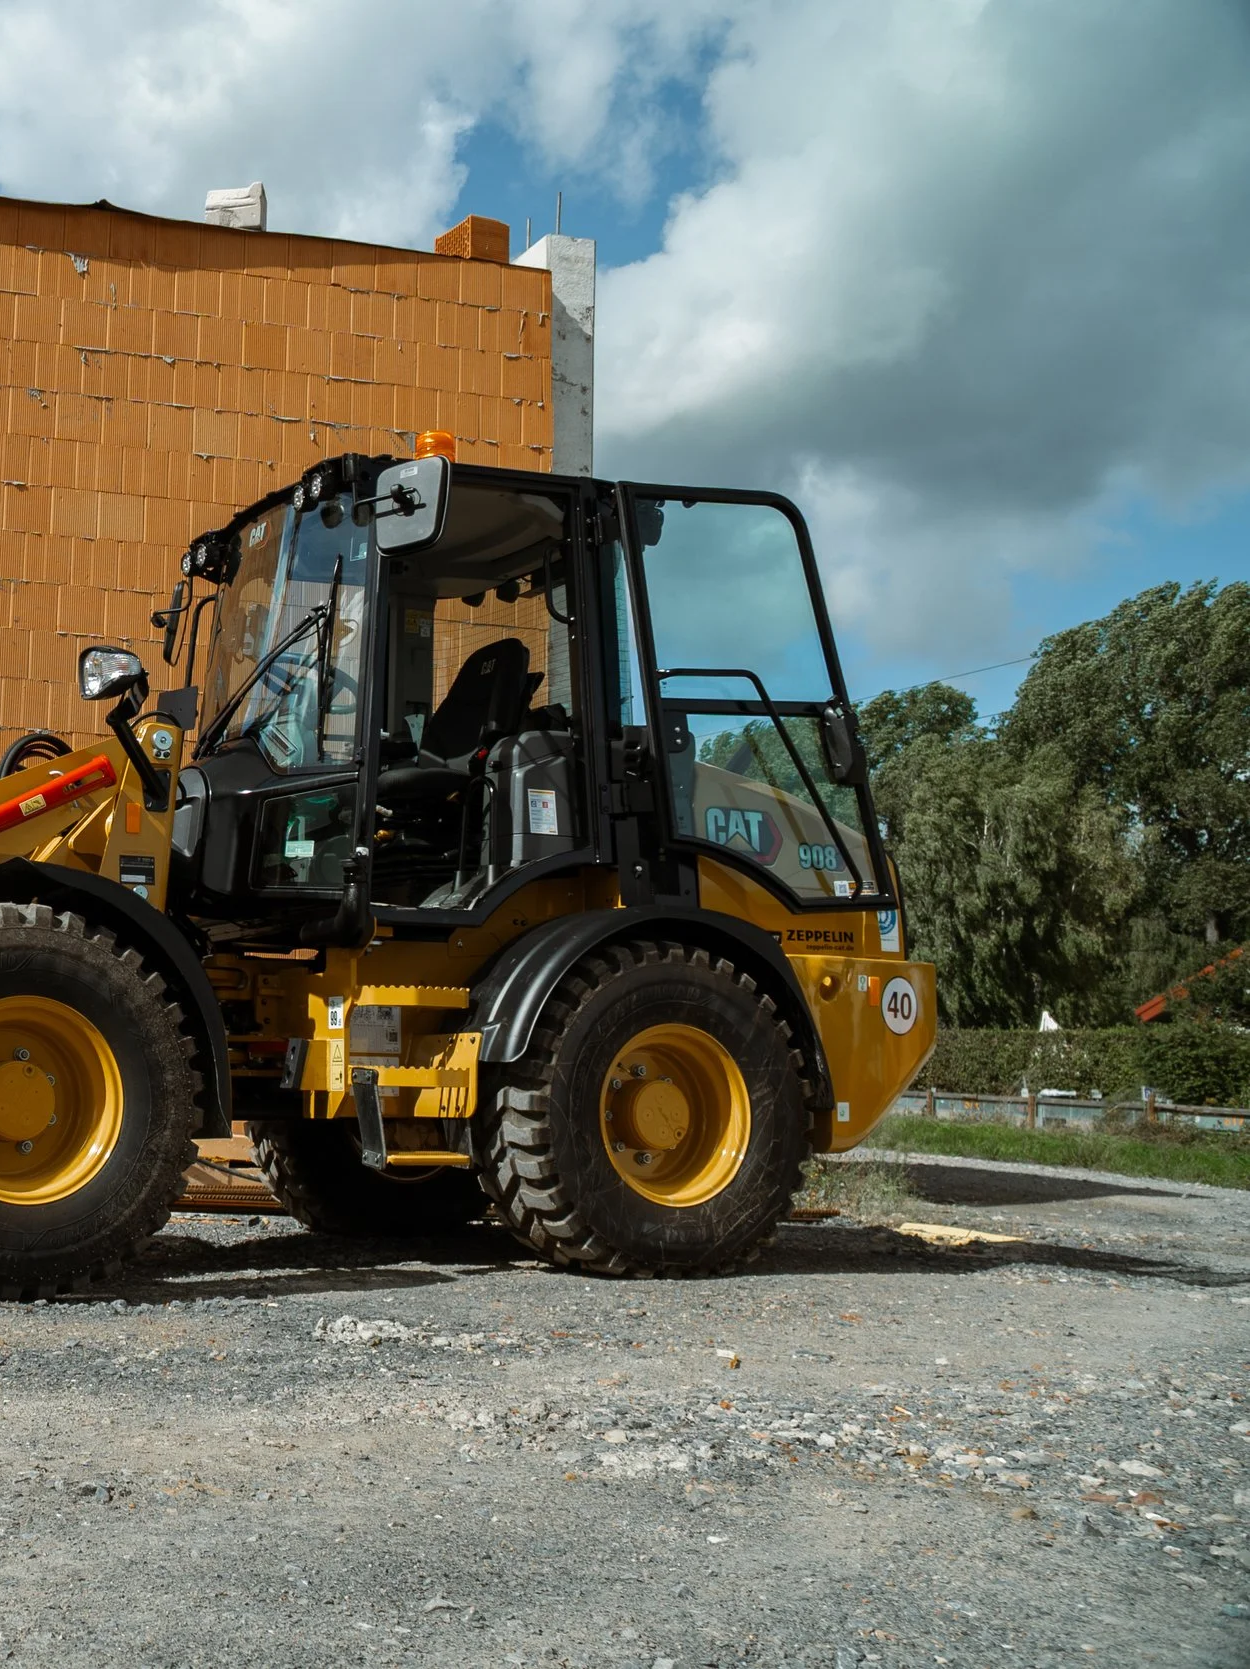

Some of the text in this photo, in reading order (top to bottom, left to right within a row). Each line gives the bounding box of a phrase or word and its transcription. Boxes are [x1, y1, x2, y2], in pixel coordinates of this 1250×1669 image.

[249, 522, 266, 547] CAT
[706, 808, 763, 852] CAT
[799, 844, 837, 870] 908
[786, 929, 854, 943] ZEPPELIN
[806, 944, 854, 952] zeppelin-cat.de
[887, 991, 912, 1020] 40
